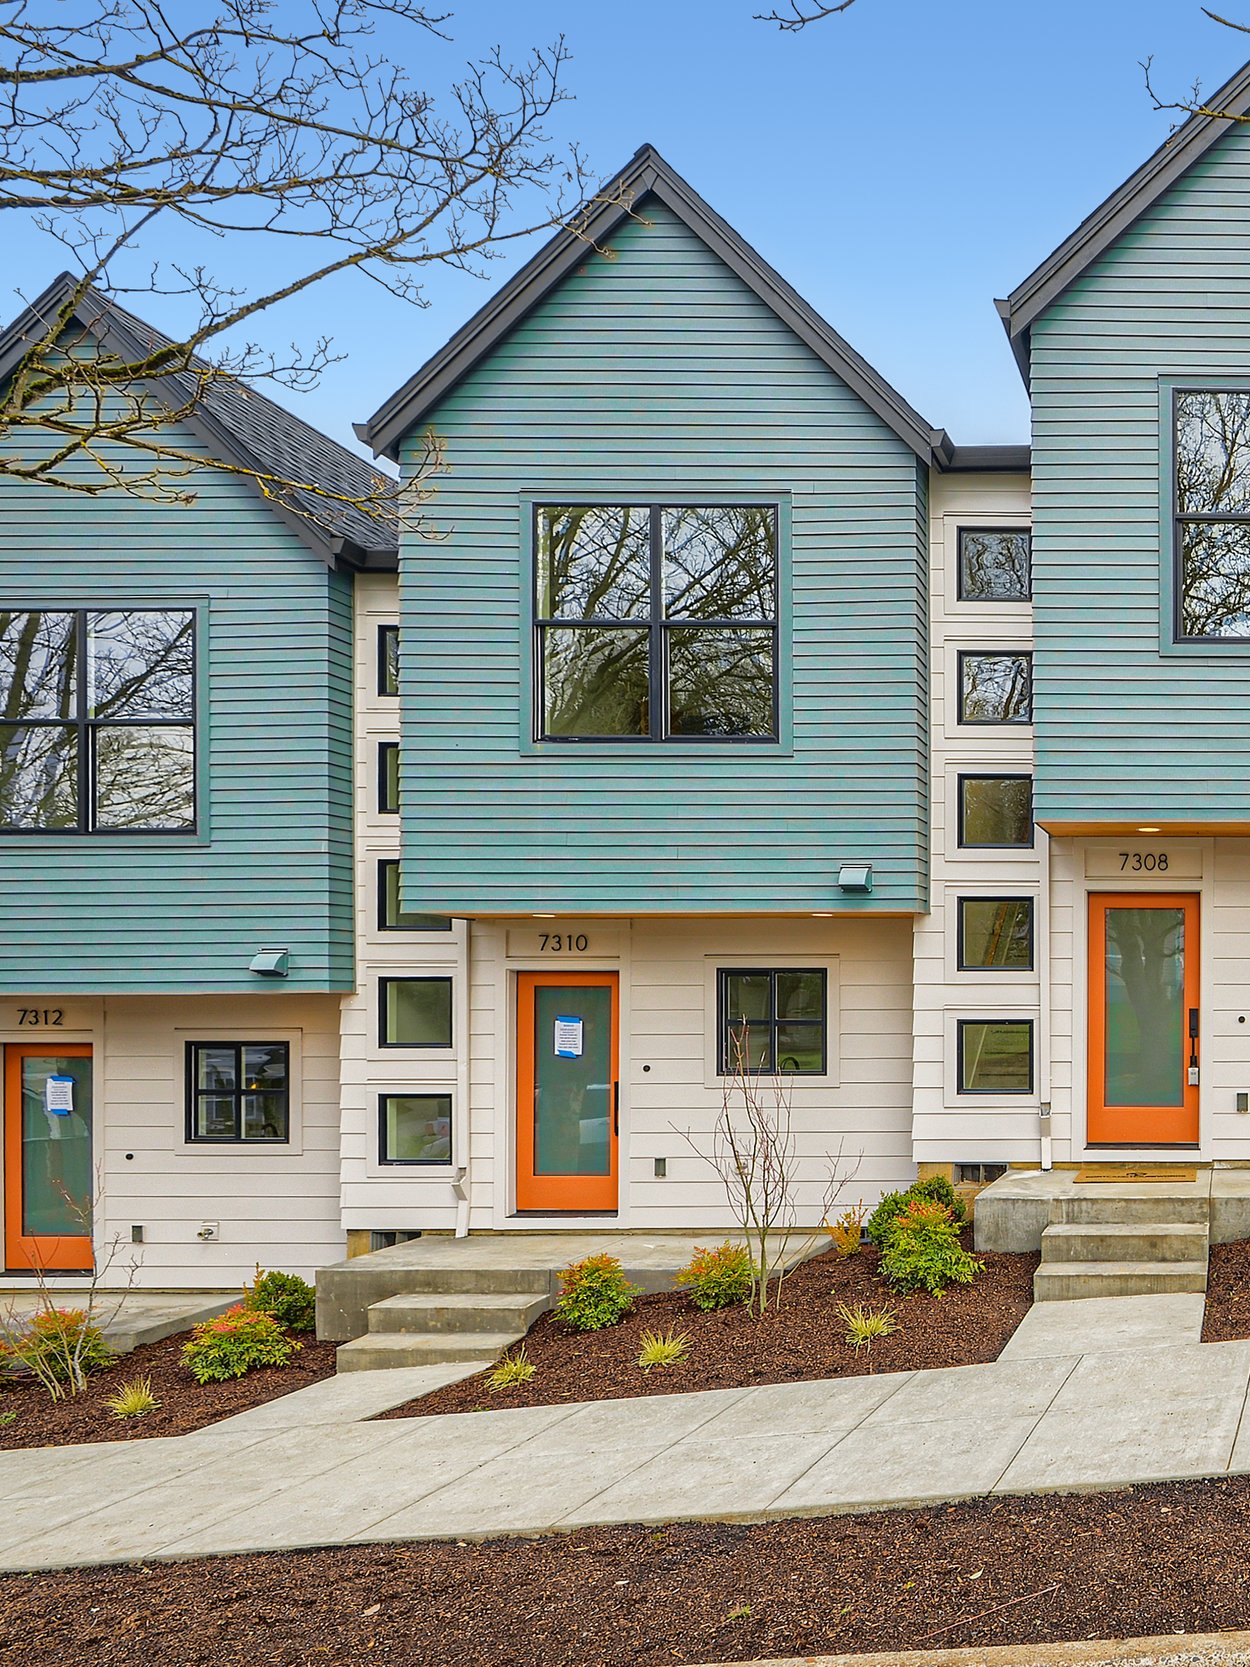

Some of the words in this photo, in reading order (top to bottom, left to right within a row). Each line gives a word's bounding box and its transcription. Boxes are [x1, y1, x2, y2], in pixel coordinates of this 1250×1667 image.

[1118, 852, 1169, 871] 7308
[538, 933, 588, 951] 7310
[16, 1008, 64, 1025] 7312
